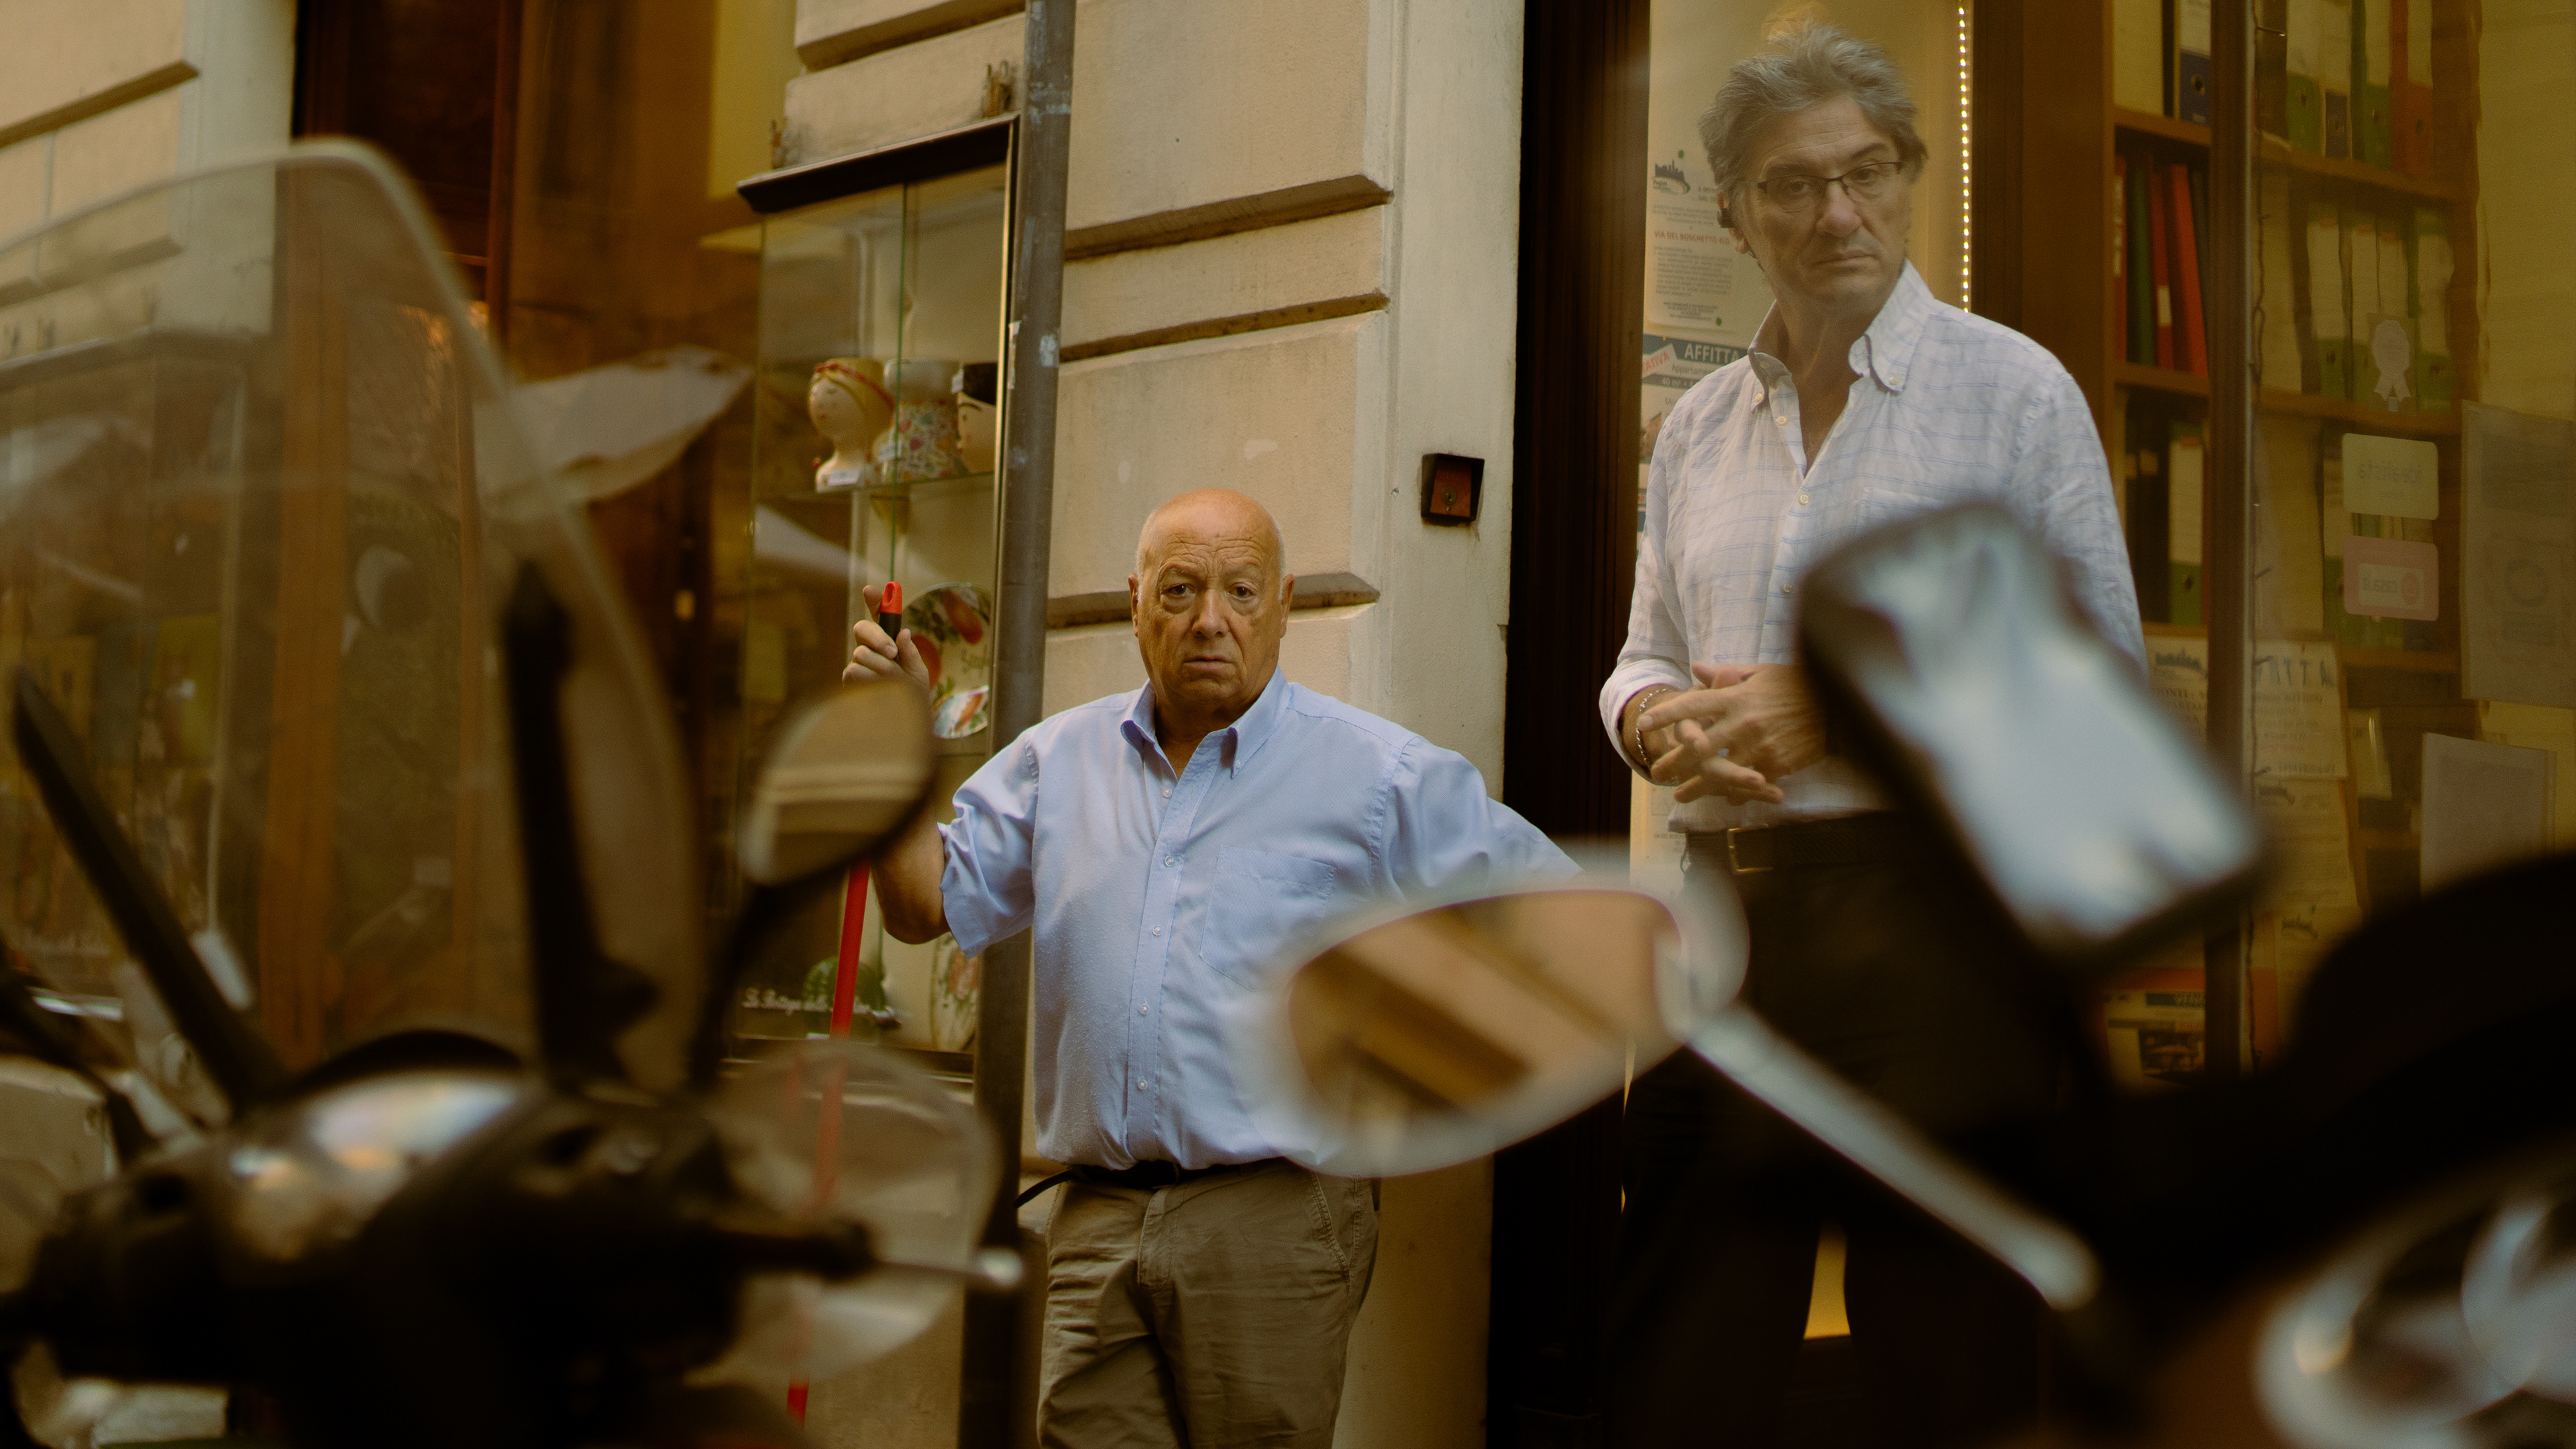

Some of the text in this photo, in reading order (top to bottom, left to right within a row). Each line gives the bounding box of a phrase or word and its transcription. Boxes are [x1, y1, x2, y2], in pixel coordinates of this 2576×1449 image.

[1666, 231, 1678, 240] DEL
[1680, 233, 1717, 244] BOSCHETTO
[1684, 343, 1739, 364] AFFITTA
